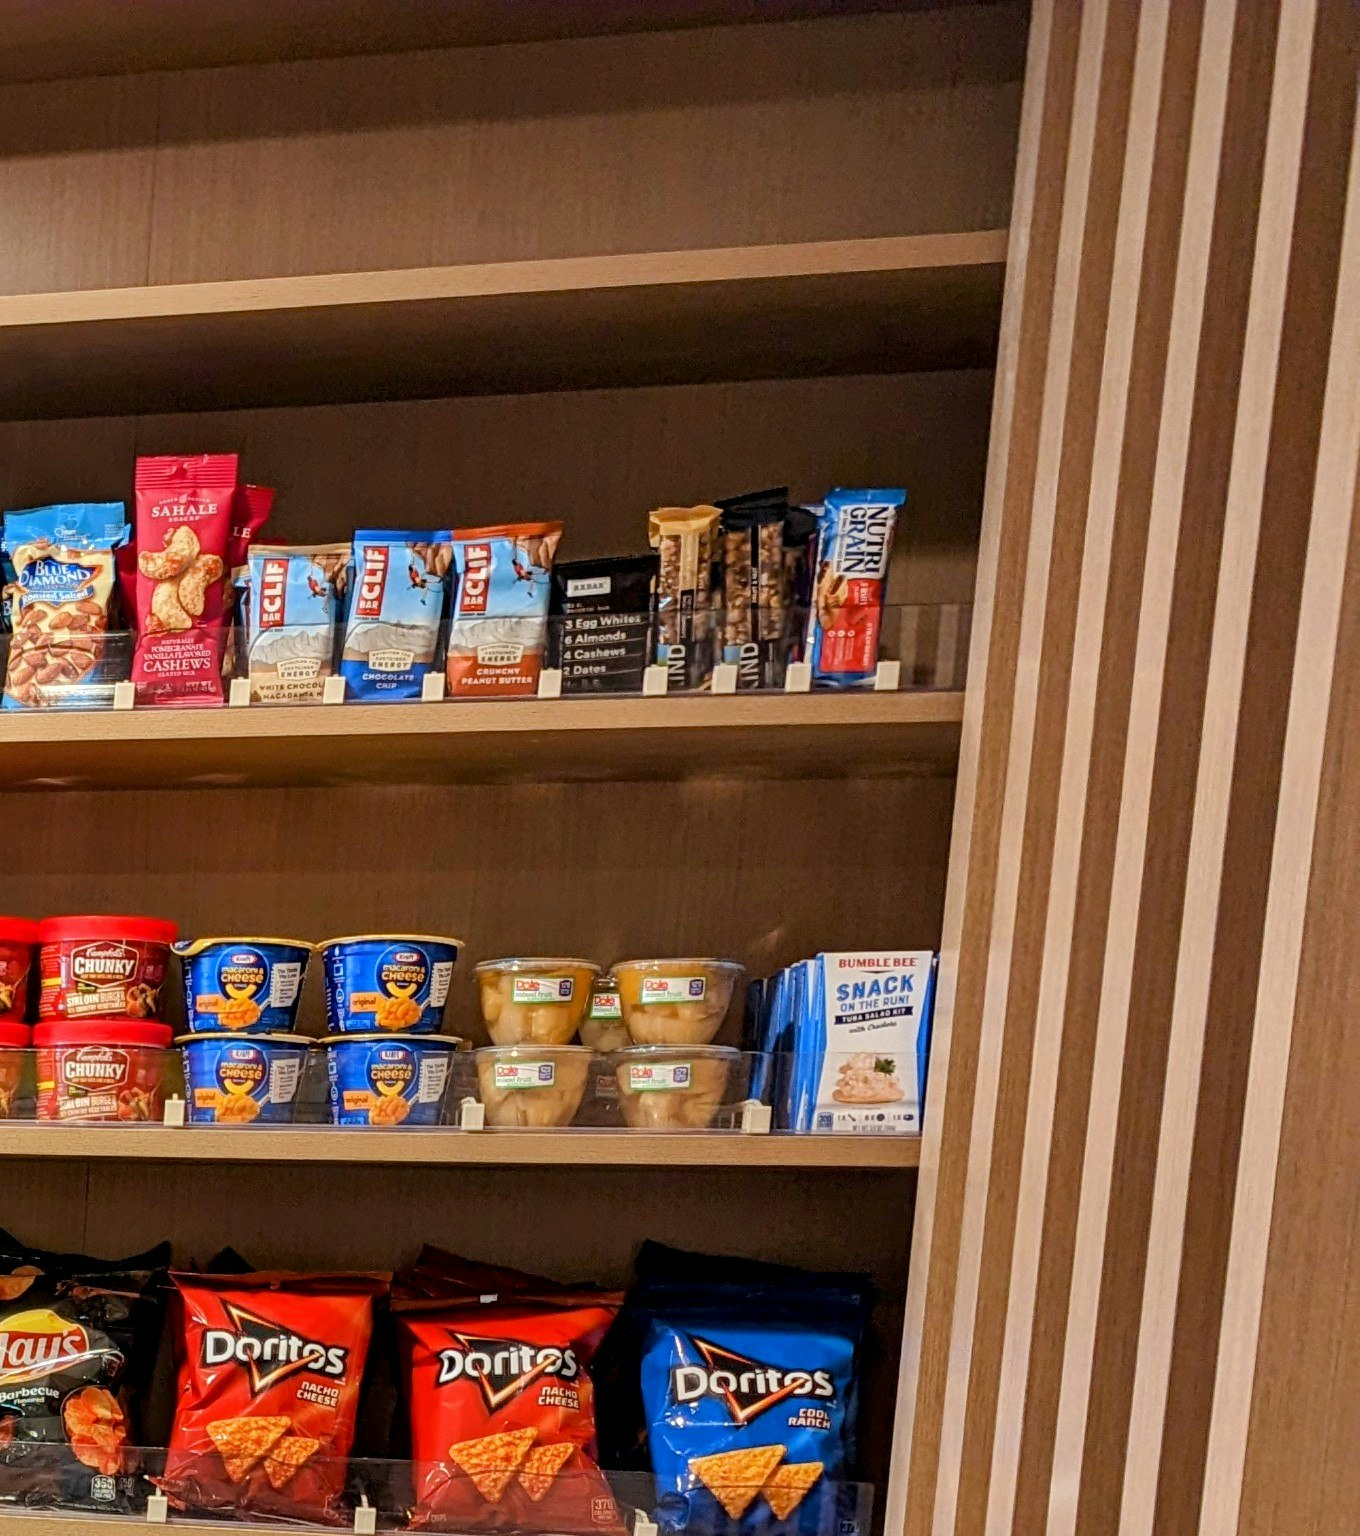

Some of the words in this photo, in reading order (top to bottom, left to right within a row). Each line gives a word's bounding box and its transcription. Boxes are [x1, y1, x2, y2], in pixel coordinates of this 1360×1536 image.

[151, 503, 218, 518] SAHALE
[34, 560, 70, 578] BLUE
[362, 547, 388, 600] CLIF
[466, 544, 490, 595] CLIF
[18, 568, 90, 587] DIAMOND
[264, 560, 287, 611] CLIF
[359, 599, 380, 610] BAR
[463, 595, 484, 606] BAR
[576, 618, 598, 631] Egg
[600, 614, 642, 627] Whites
[575, 631, 627, 644] Almonds
[574, 647, 626, 659] Cashews
[143, 658, 212, 672] CASHEWS
[573, 663, 607, 675] Dates
[74, 959, 134, 975] CHUNKY
[838, 957, 891, 969] BUMBLE
[892, 957, 917, 967] BEE
[516, 979, 541, 992] Dole
[644, 979, 669, 992] Dole
[836, 973, 914, 1002] SNACK
[197, 998, 219, 1009] original
[353, 998, 377, 1008] original
[839, 1002, 856, 1013] ON
[859, 999, 879, 1011] THE
[66, 1062, 125, 1079] CHUNKY
[496, 1066, 519, 1078] Dole
[631, 1067, 653, 1079] Dole
[197, 1093, 216, 1104] original
[346, 1095, 369, 1105] original
[205, 1329, 346, 1375] Doritos
[437, 1347, 578, 1383] Doritos
[675, 1367, 835, 1402] Doritos
[538, 1395, 580, 1409] CHEESE
[798, 1407, 830, 1420] COOL
[788, 1416, 831, 1430] RANCH
